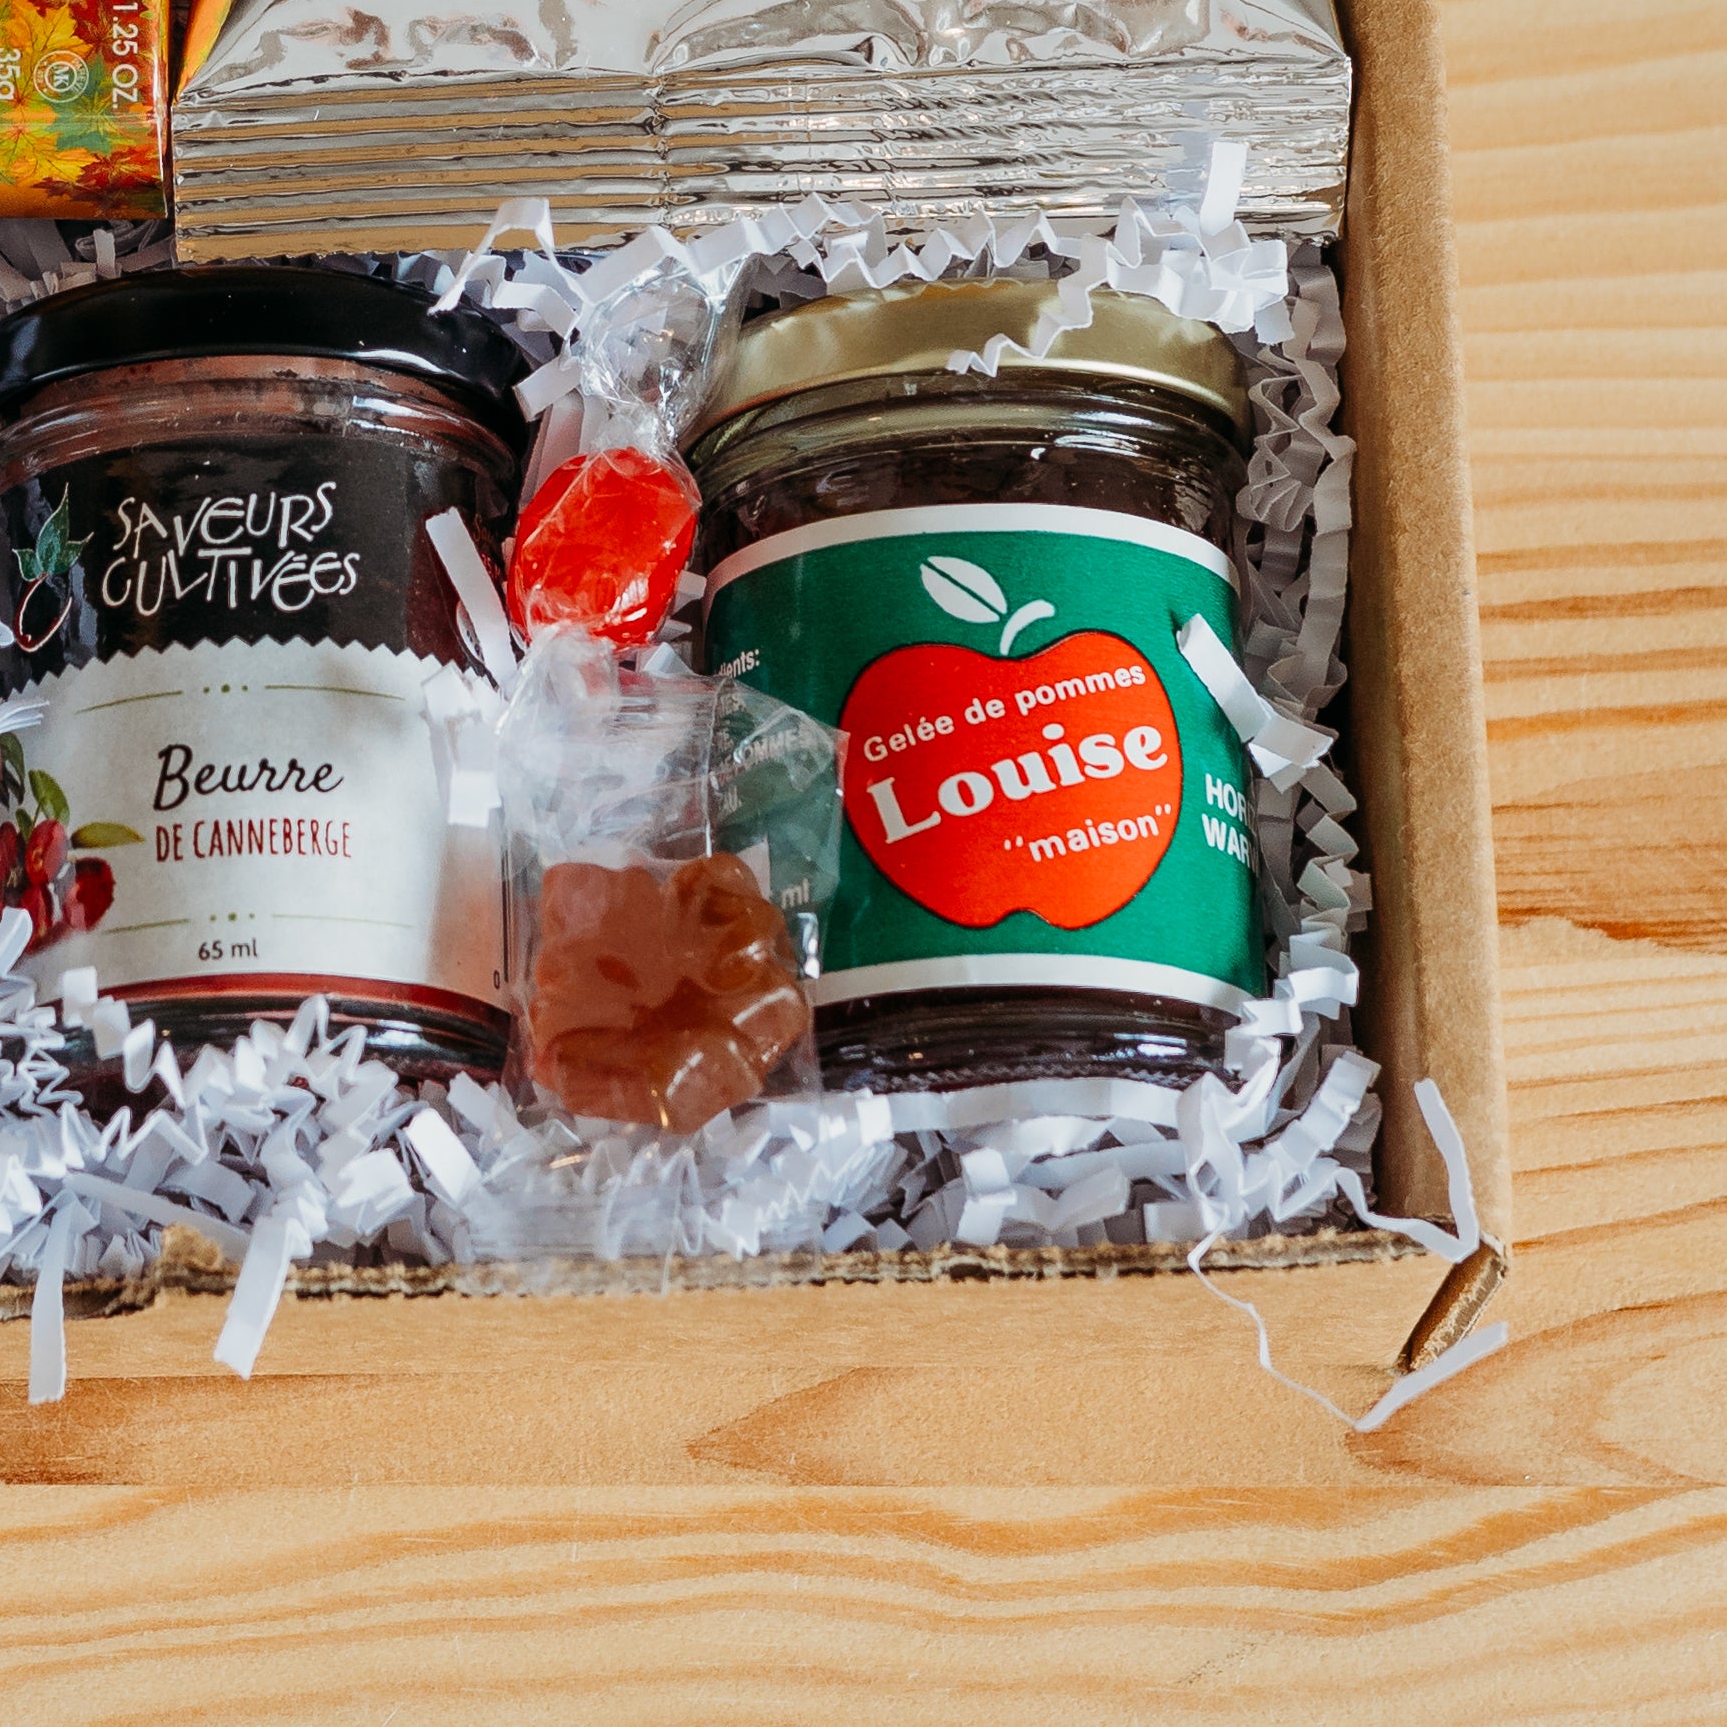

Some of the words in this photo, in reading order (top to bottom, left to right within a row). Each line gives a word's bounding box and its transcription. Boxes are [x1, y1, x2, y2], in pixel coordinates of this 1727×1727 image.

[112, 2, 139, 56] 1.25
[112, 63, 139, 109] OZ.
[113, 481, 336, 558] SAVEURS
[863, 714, 954, 763] Gelée
[964, 697, 1006, 724] de
[1016, 664, 1146, 717] pommes
[153, 744, 344, 812] Beurre
[867, 723, 1168, 844] Louise
[155, 823, 184, 863] DE
[193, 819, 351, 858] CANNEBERGE
[1003, 804, 1172, 862] "maison"
[781, 878, 810, 909] ml
[198, 941, 224, 962] 65
[230, 938, 258, 959] ml
